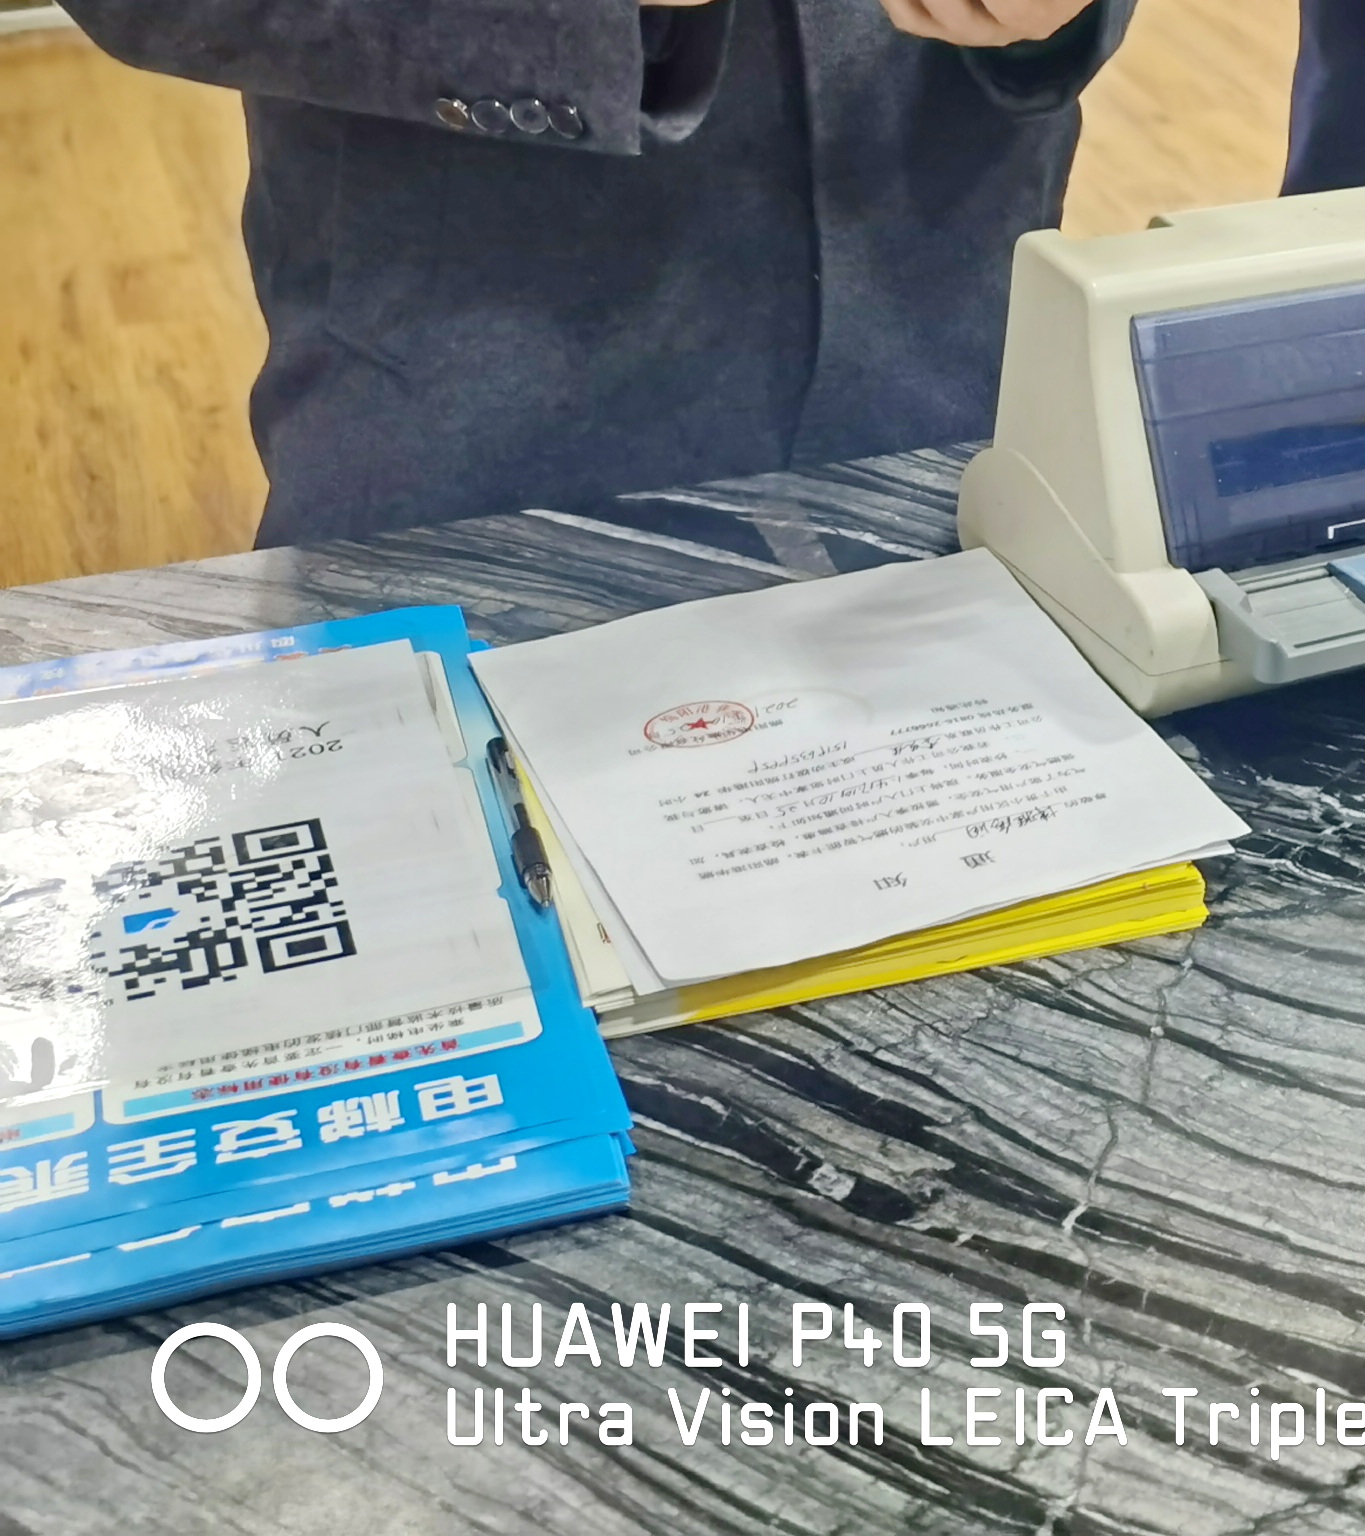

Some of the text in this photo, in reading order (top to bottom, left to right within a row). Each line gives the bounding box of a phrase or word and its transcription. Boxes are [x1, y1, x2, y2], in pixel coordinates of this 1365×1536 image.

[870, 849, 1000, 893] 通知
[0, 1065, 504, 1213] 电梯安全乘
